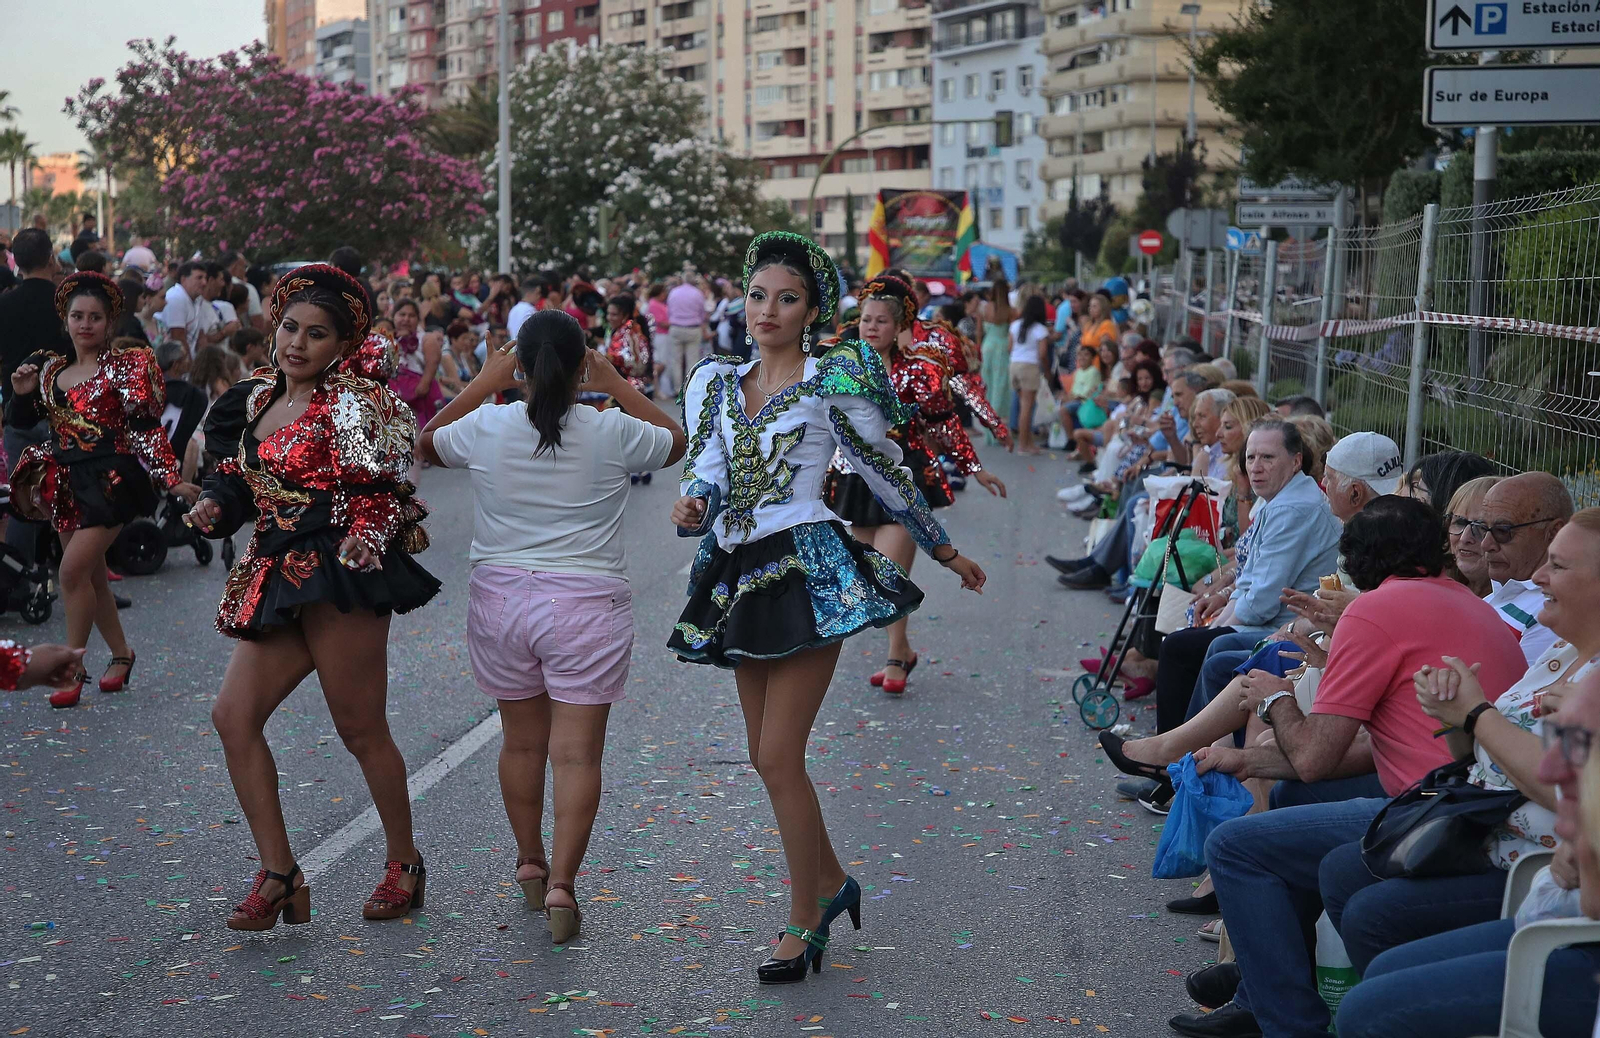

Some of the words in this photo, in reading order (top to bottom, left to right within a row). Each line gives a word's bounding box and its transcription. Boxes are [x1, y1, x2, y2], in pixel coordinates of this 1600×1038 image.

[1523, 0, 1590, 14] Estación
[1481, 6, 1503, 33] P
[1435, 90, 1462, 102] Sur
[1469, 91, 1488, 101] de
[1495, 89, 1549, 104] Europa
